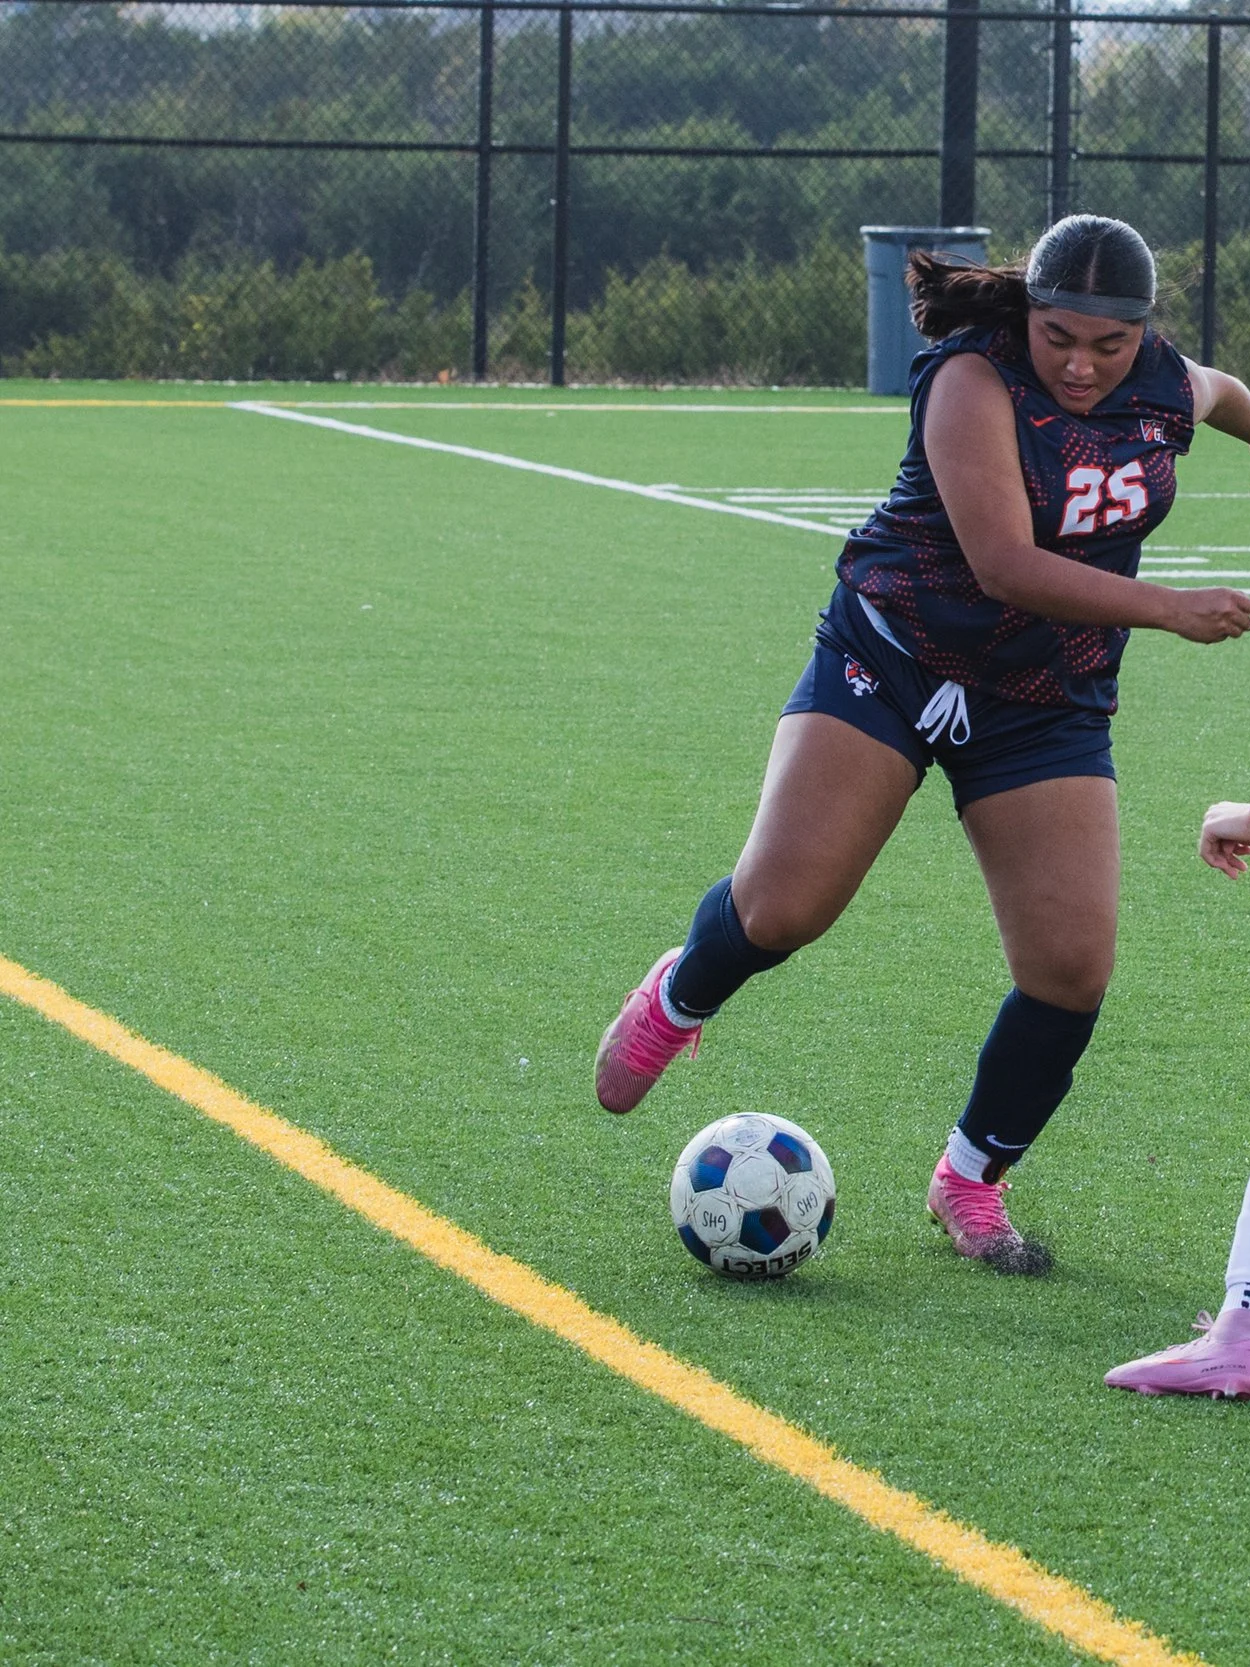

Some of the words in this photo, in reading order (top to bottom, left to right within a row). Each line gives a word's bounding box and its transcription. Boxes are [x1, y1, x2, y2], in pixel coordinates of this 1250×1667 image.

[1057, 459, 1149, 537] 25
[797, 1191, 819, 1216] GHS
[702, 1210, 727, 1232] GHS
[722, 1240, 812, 1275] SELECT
